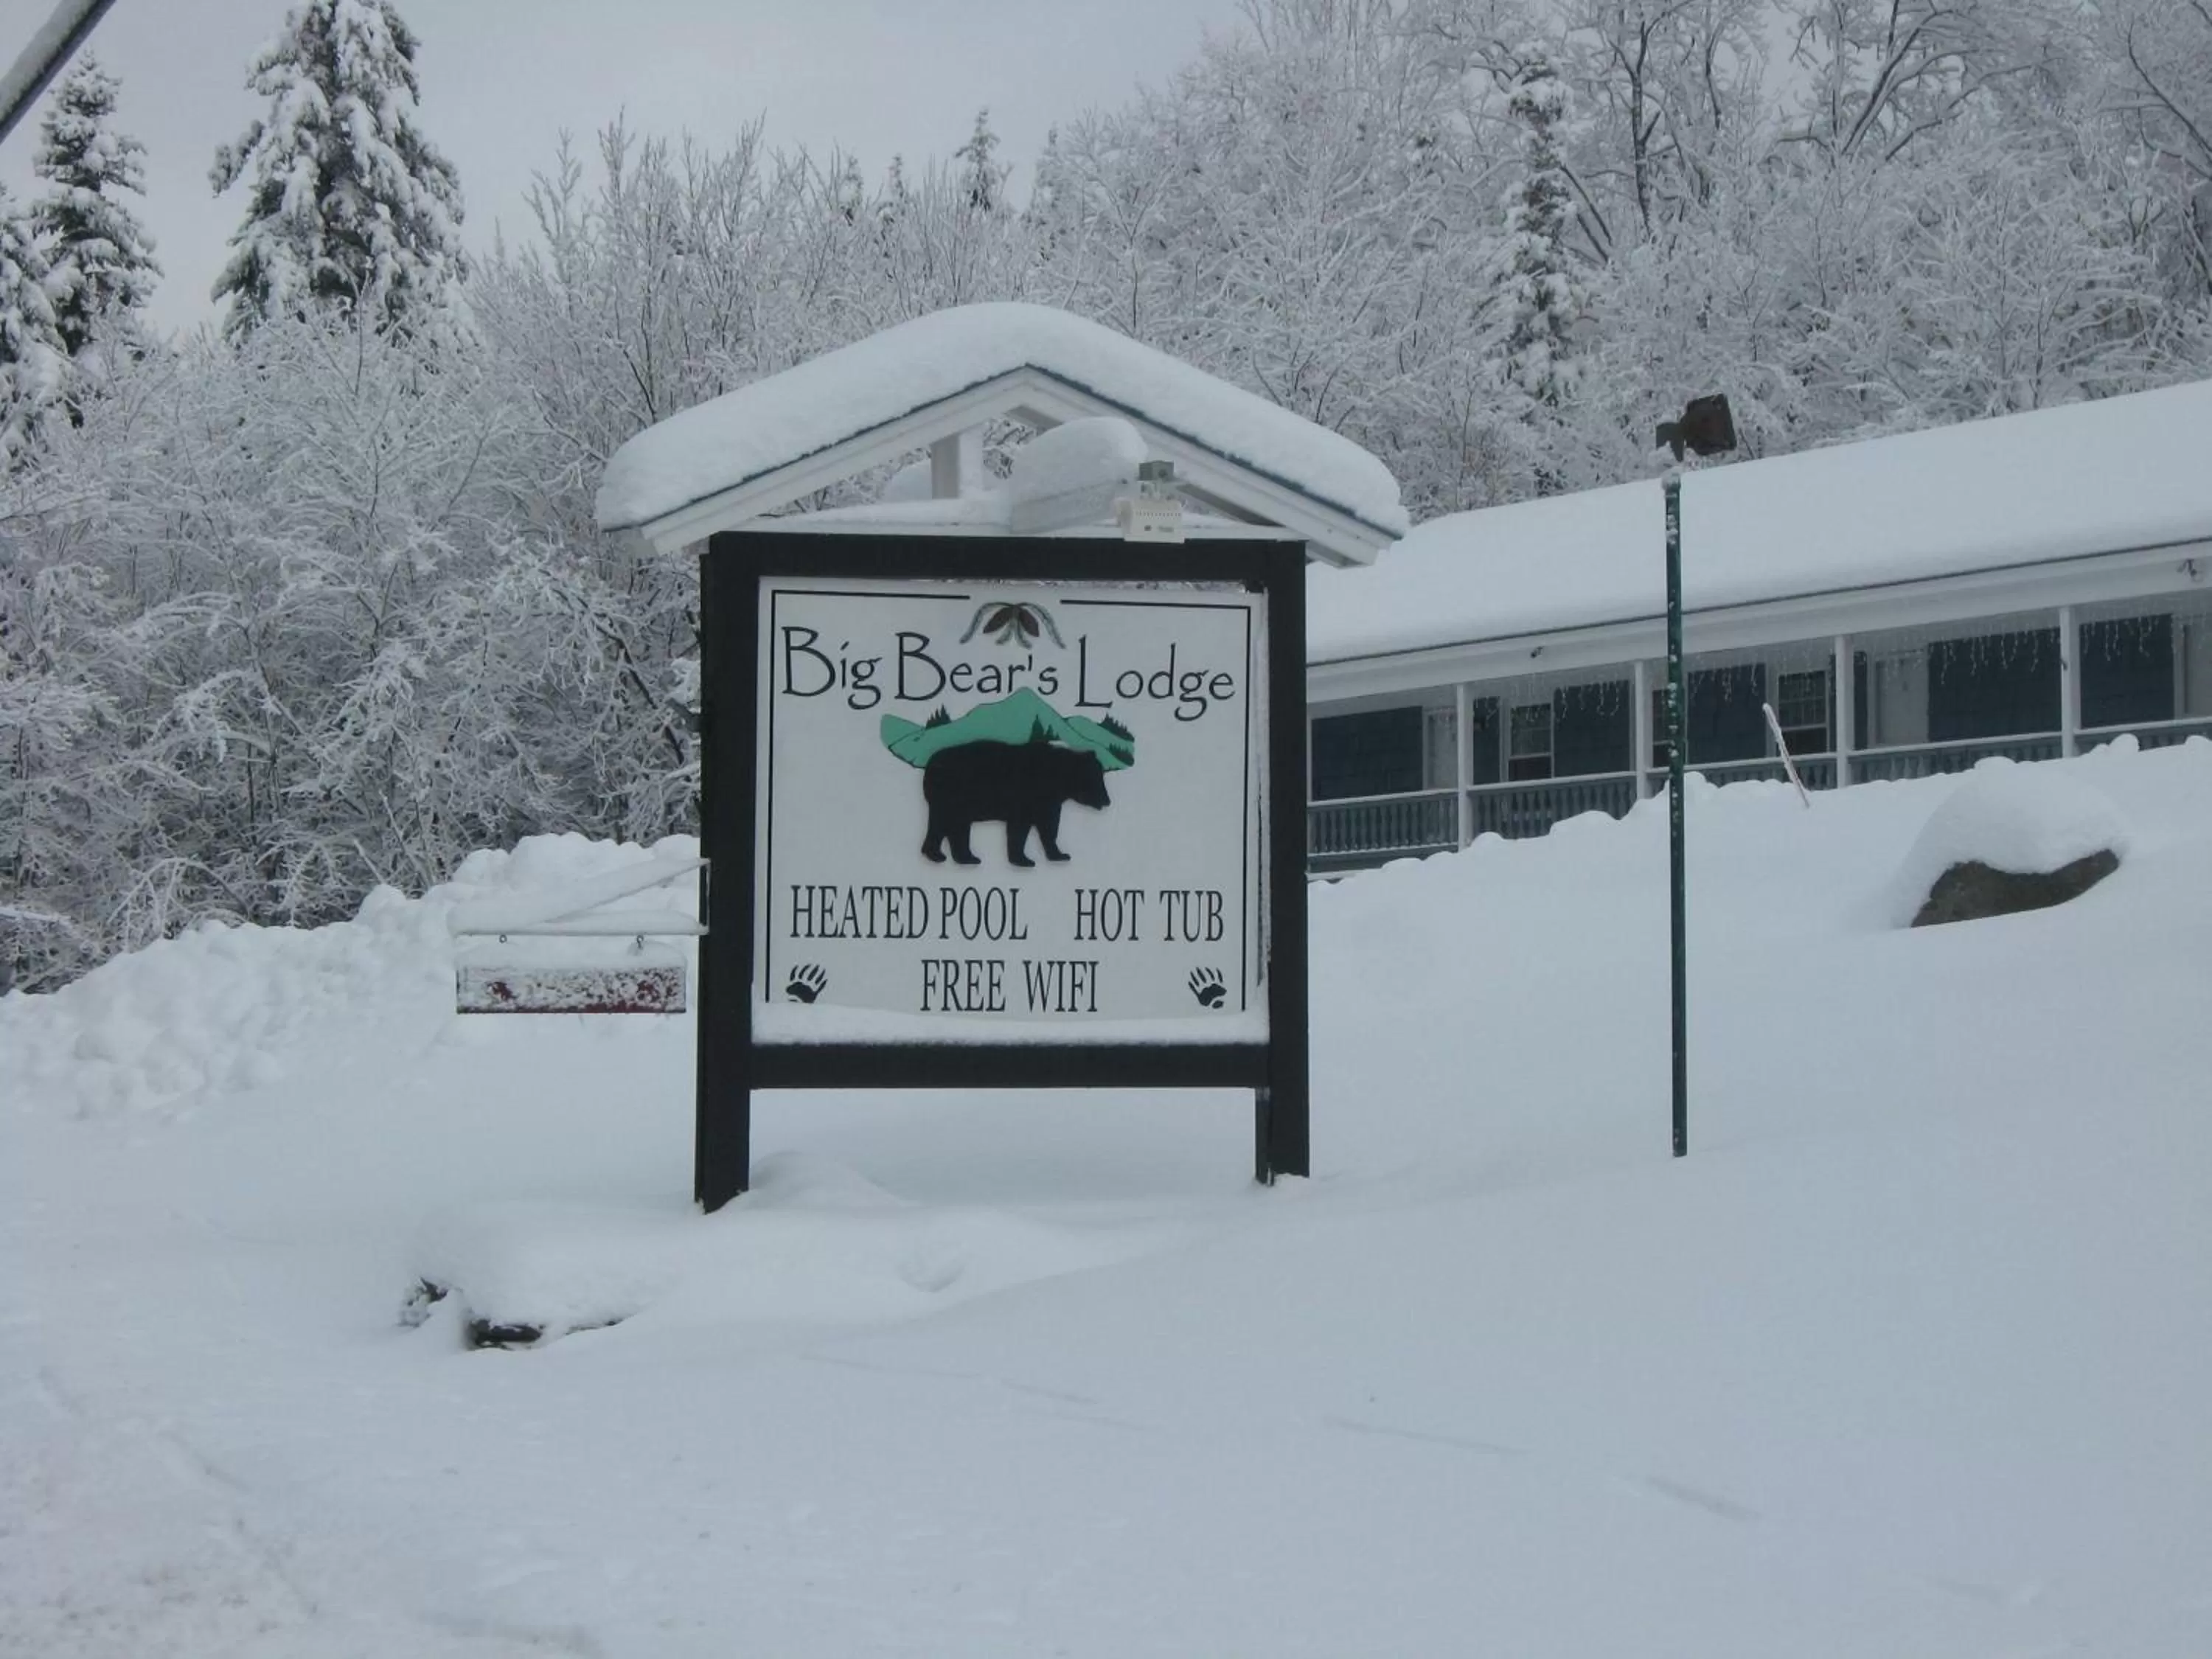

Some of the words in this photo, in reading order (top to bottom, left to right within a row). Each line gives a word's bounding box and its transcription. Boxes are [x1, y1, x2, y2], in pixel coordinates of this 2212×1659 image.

[782, 626, 883, 709] Big
[894, 632, 1059, 702] Bear's
[1074, 635, 1237, 721] Lodge
[790, 885, 928, 939] HEATED
[939, 887, 1028, 940] POOL
[1074, 888, 1144, 942] HOT
[1159, 889, 1224, 942] TUB
[919, 959, 1006, 1012] FREE
[1023, 960, 1099, 1012] WIFI
